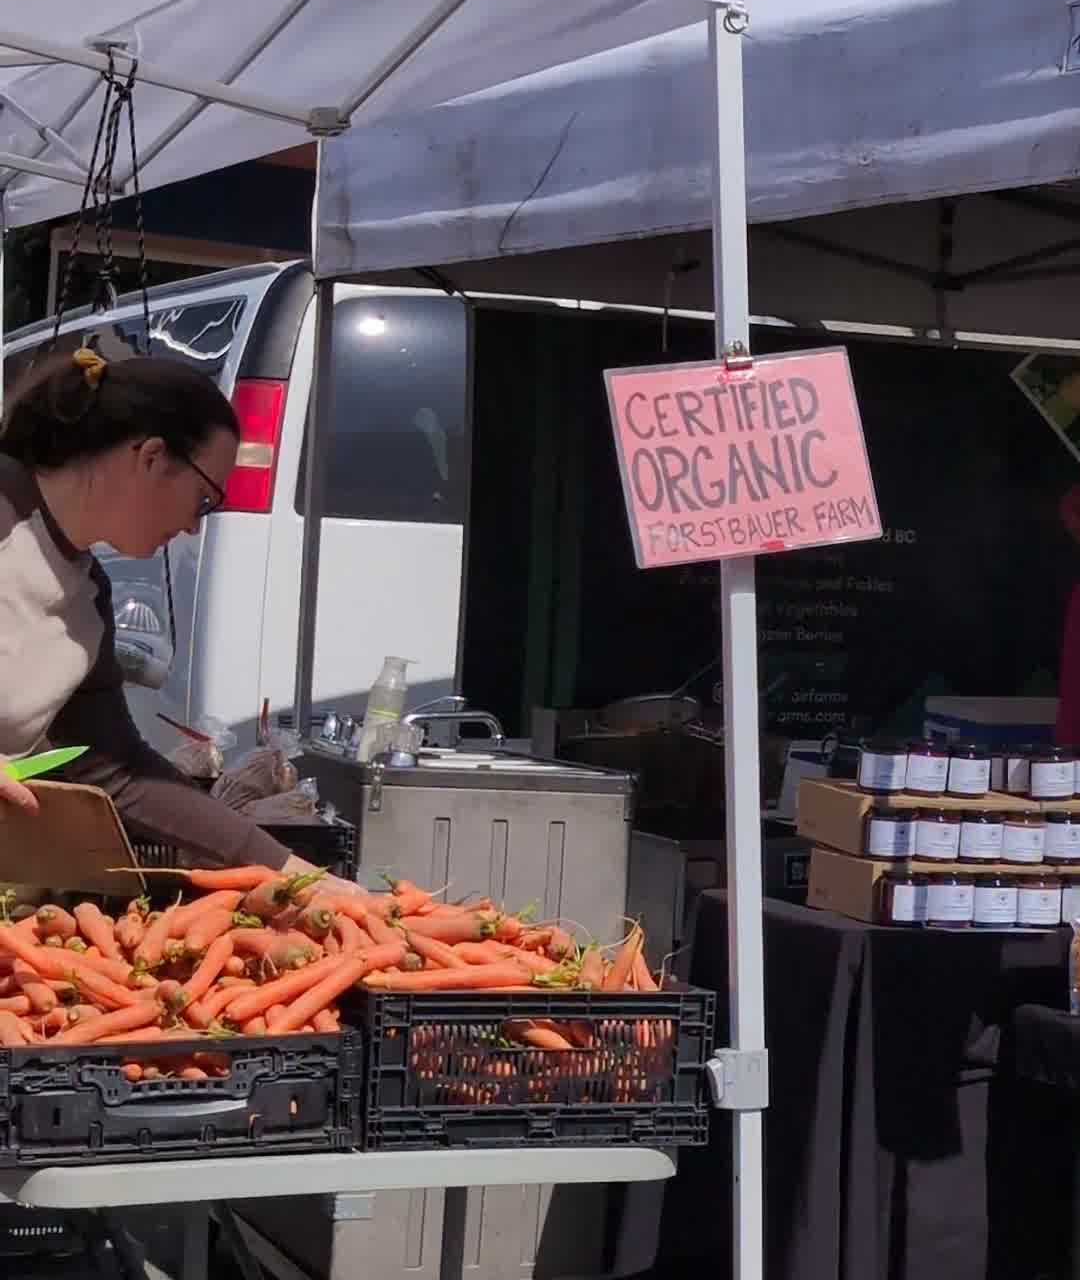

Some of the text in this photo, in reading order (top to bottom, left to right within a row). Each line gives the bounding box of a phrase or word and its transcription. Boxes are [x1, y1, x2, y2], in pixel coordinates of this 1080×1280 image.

[625, 376, 819, 440] CERTIFIED
[631, 430, 838, 514] ORGANIC
[647, 496, 874, 555] FORSTBAUER FARM
